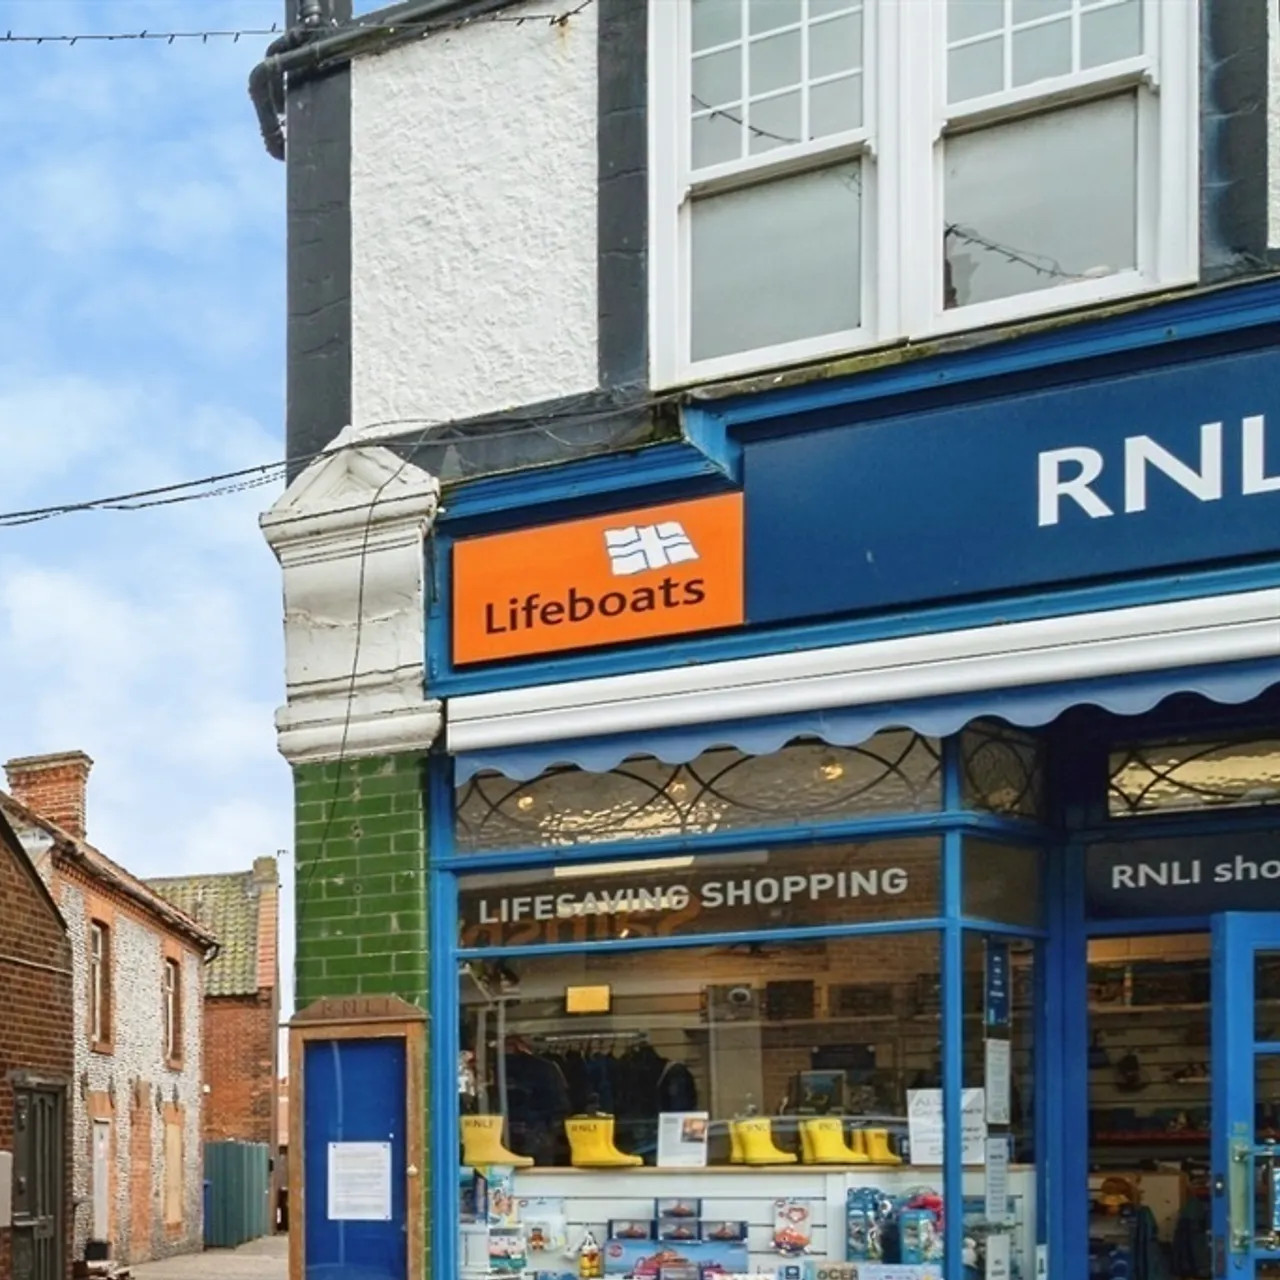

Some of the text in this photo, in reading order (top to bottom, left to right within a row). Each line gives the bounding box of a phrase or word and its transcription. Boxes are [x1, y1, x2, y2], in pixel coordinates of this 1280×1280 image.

[485, 577, 705, 634] Lifeboats
[479, 867, 908, 924] LIFESAVING SHOPPING
[1112, 859, 1201, 889] RNLI
